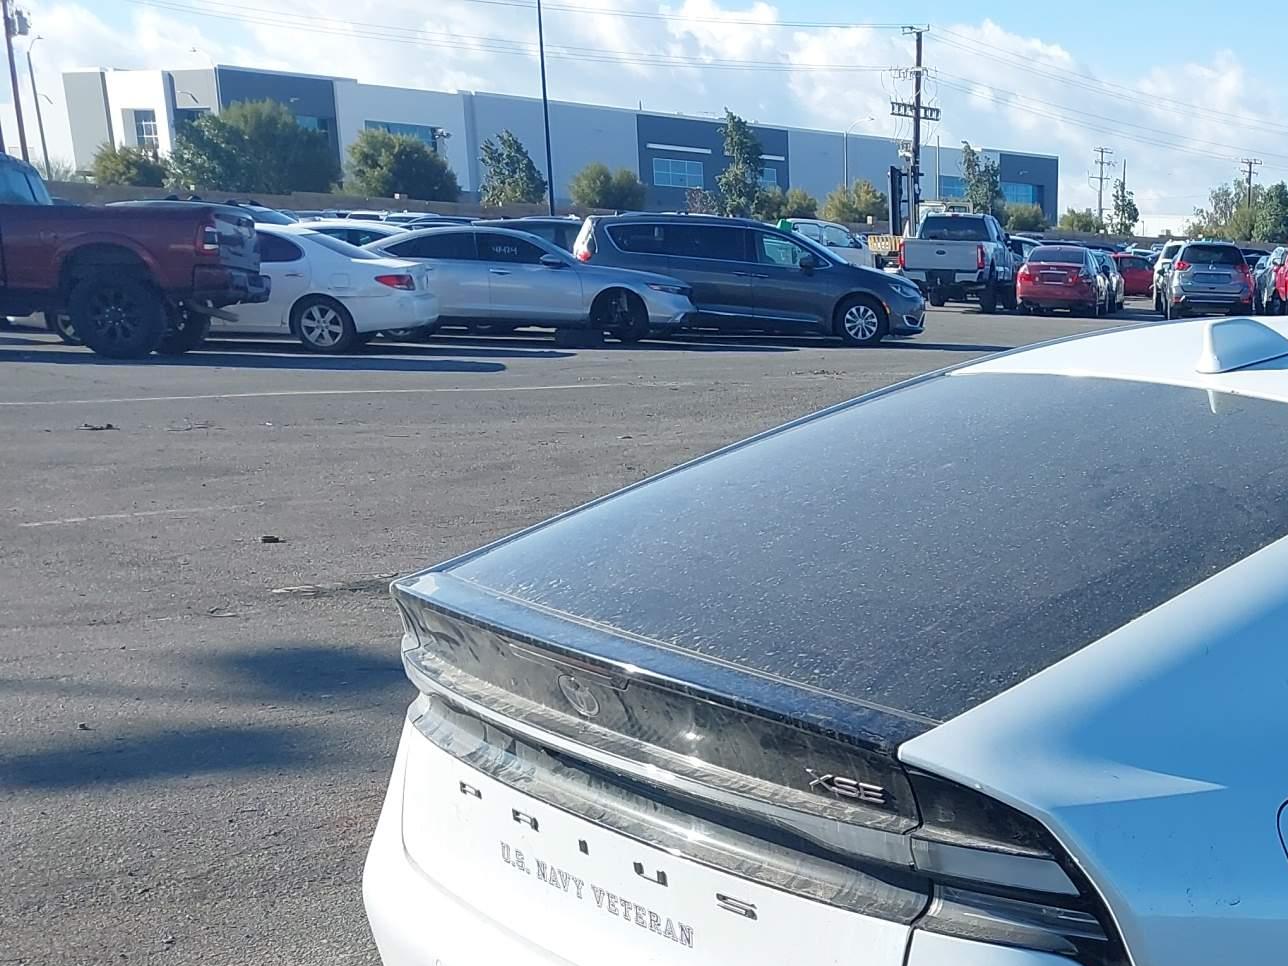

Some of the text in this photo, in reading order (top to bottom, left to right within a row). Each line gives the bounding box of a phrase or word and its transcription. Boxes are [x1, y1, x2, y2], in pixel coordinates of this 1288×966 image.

[804, 767, 887, 805] XSE
[459, 780, 758, 921] PRIUS
[499, 840, 695, 949] U.S. NAVY VETERAN
